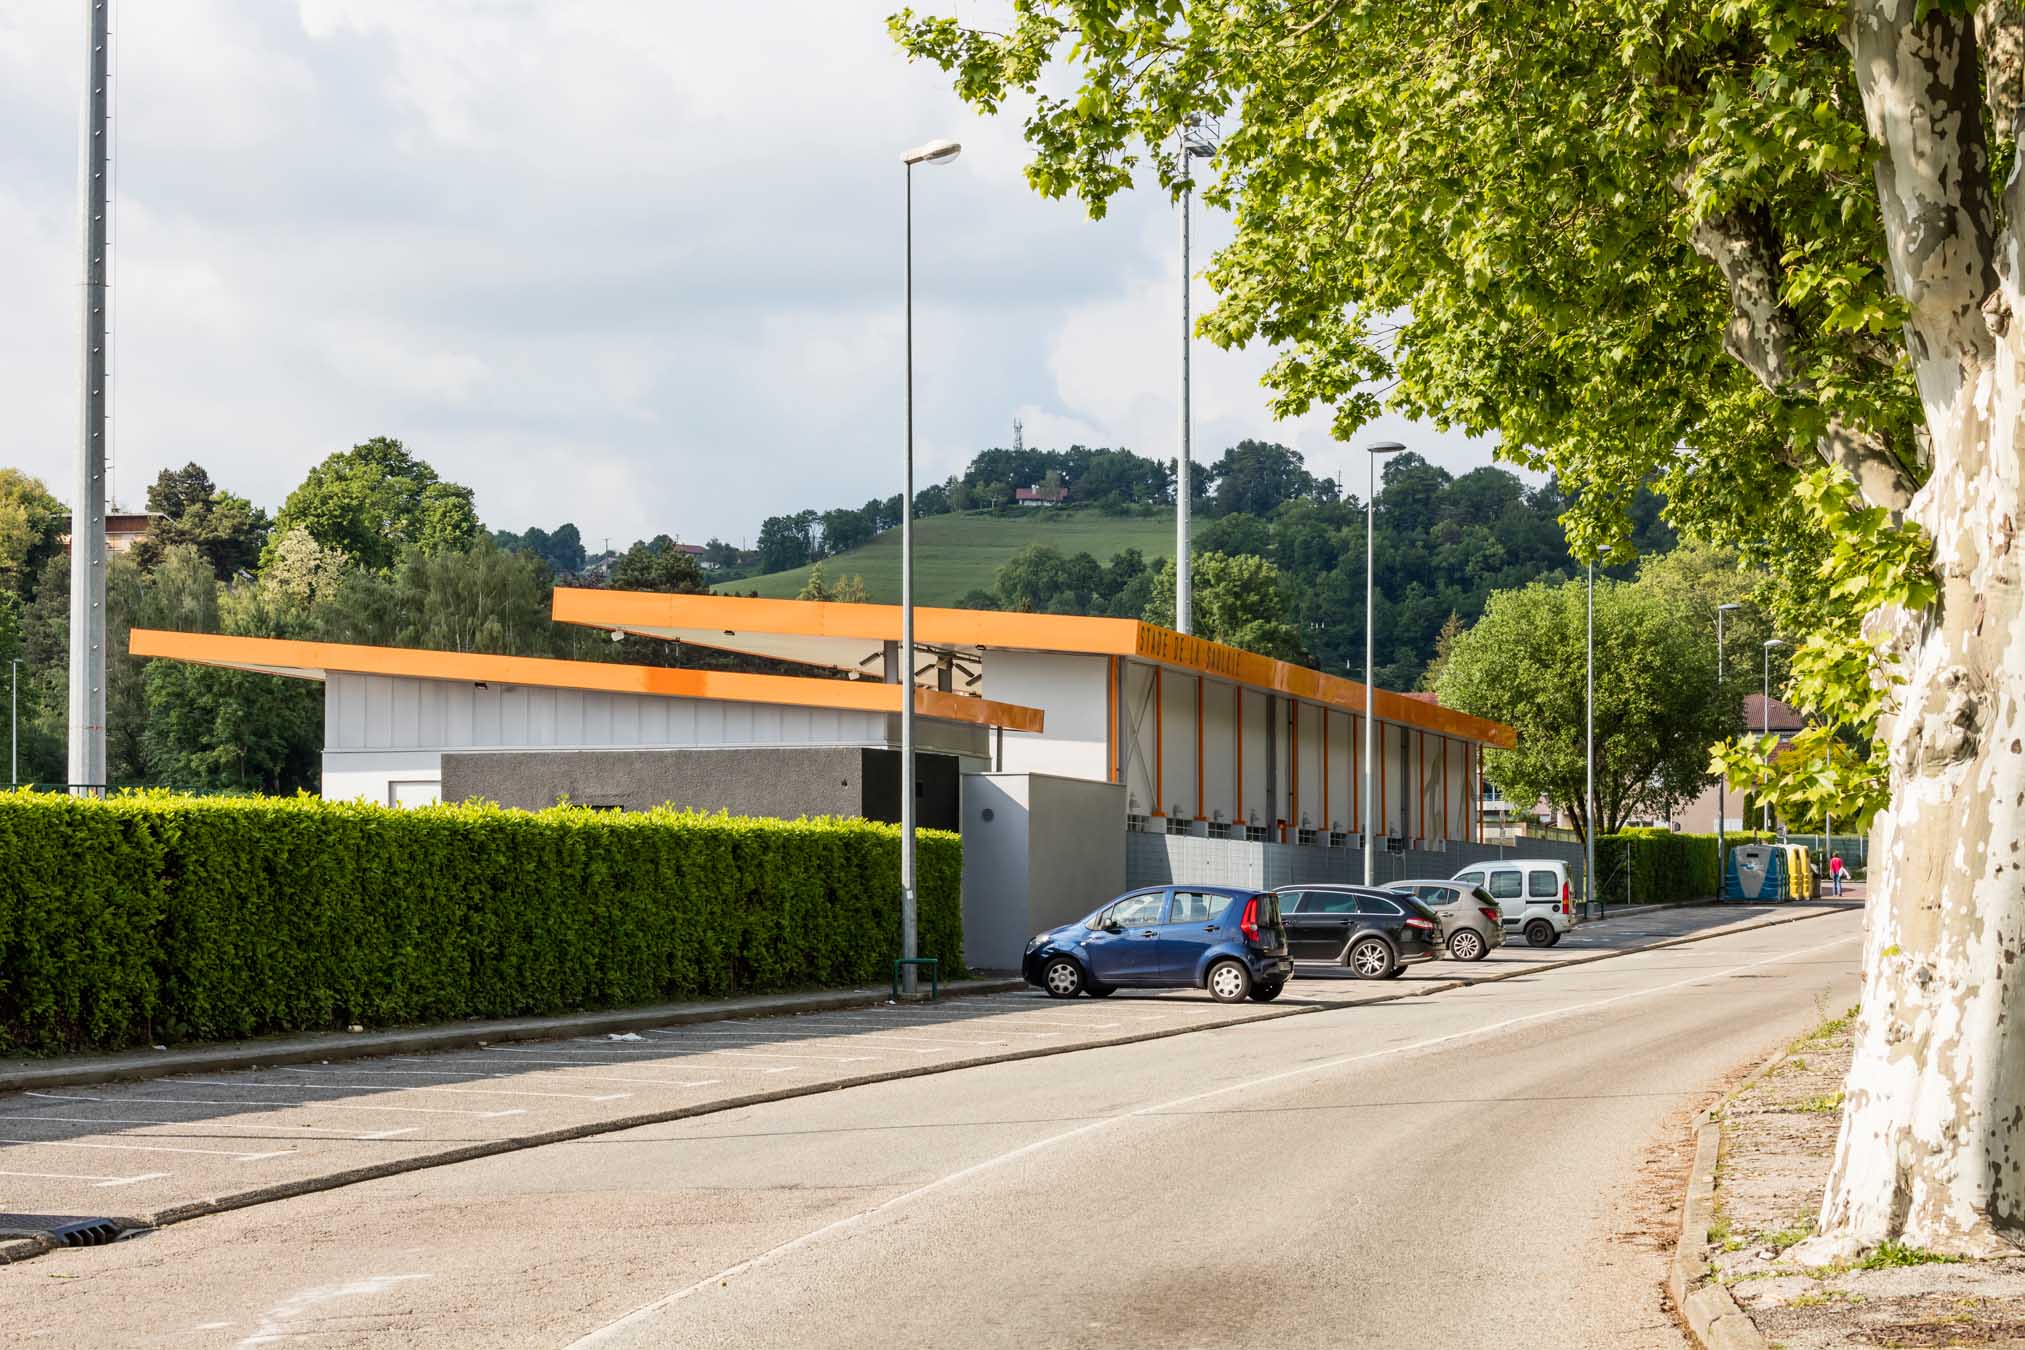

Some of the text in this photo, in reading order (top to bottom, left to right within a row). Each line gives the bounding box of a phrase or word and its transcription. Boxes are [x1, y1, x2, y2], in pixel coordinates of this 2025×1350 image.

[1140, 625, 1168, 657] STADE
[1173, 636, 1185, 662] DE
[1189, 639, 1201, 665] LA
